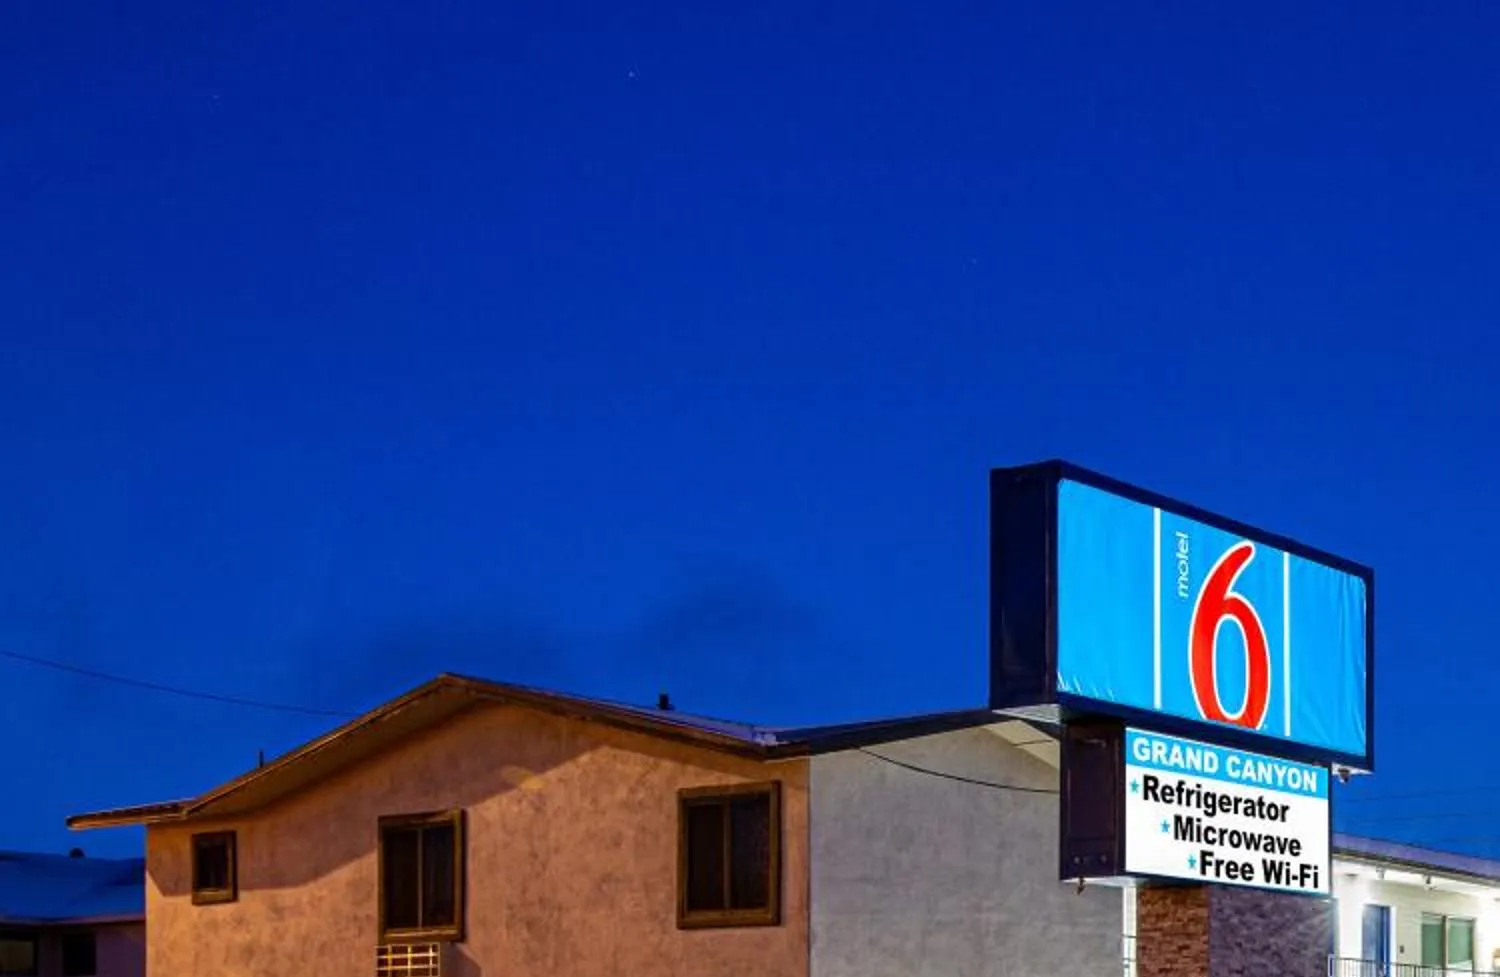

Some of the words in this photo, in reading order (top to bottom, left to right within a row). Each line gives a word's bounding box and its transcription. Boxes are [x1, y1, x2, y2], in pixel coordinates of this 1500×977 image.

[1176, 531, 1191, 599] motel
[1188, 540, 1271, 731] 6
[1133, 737, 1219, 776] GRAND
[1226, 756, 1318, 793] CANYON
[1143, 774, 1290, 823] Refrigerator
[1173, 815, 1302, 857] Microwave
[1199, 850, 1255, 882] Free
[1262, 858, 1319, 889] Wi-Fi
